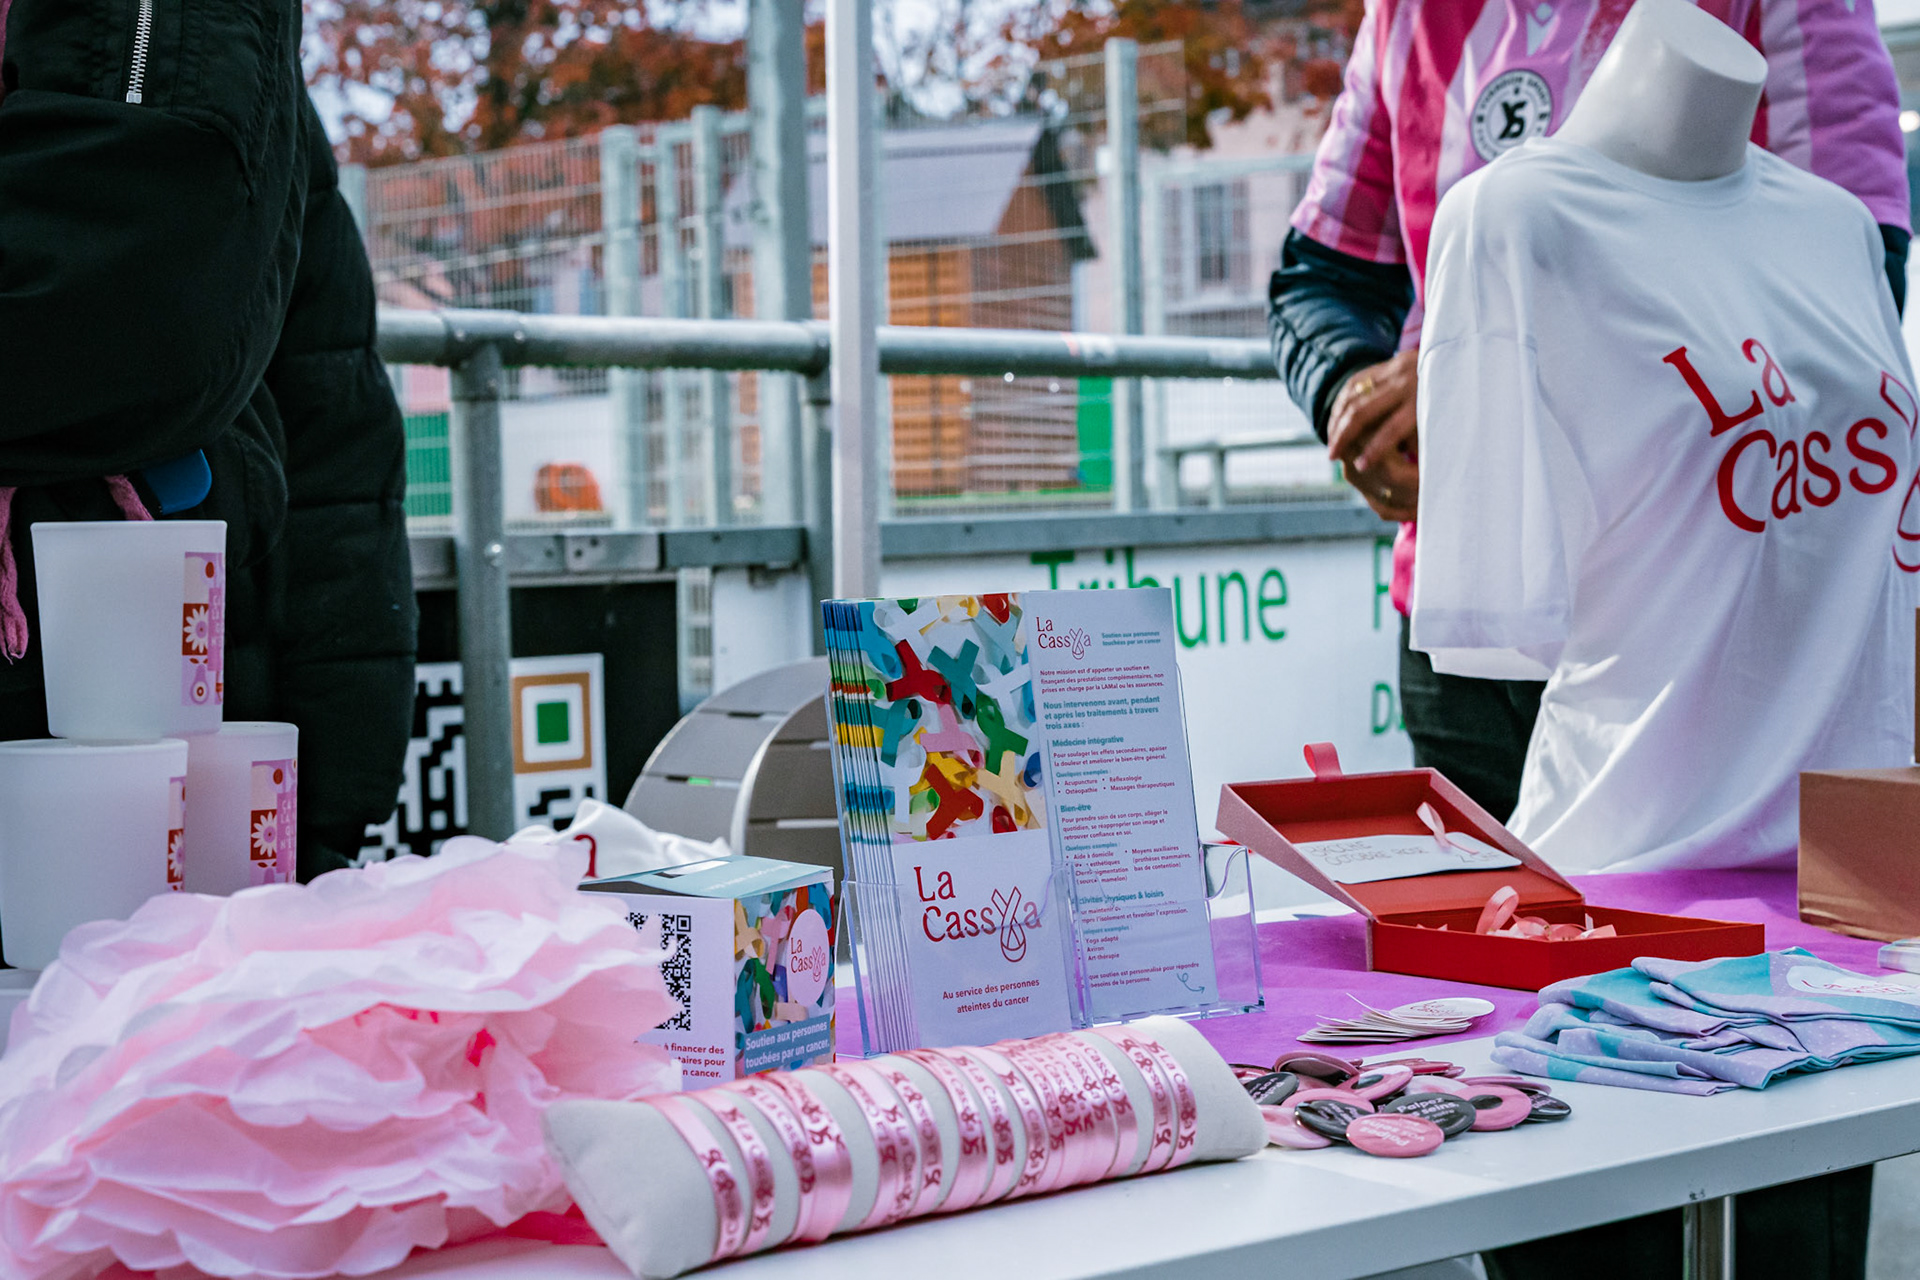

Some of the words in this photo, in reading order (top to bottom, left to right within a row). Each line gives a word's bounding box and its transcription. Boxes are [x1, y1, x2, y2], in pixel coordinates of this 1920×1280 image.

[1663, 338, 1796, 437] La
[1036, 617, 1053, 631] La
[1064, 700, 1106, 708] intervenons
[1131, 696, 1160, 704] pendant
[1087, 709, 1127, 717] traitements
[1087, 736, 1124, 745] intégrative
[914, 866, 956, 902] La
[1138, 891, 1143, 899] &
[791, 938, 802, 954] La
[1176, 962, 1199, 970] répondre
[943, 991, 953, 999] Au
[956, 987, 983, 998] service
[985, 985, 998, 993] des
[1000, 979, 1040, 993] personnes
[957, 1003, 990, 1013] atteintes
[993, 999, 1002, 1007] du
[1005, 996, 1029, 1006] cancer
[746, 1035, 776, 1050] Soutien
[777, 1032, 790, 1041] aux
[792, 1022, 827, 1041] personnes
[671, 1043, 706, 1053] financer
[709, 1046, 724, 1054] des
[746, 1051, 780, 1068] touchées
[782, 1048, 794, 1062] par
[796, 1045, 804, 1055] un
[806, 1039, 830, 1053] cancer.
[704, 1059, 725, 1067] pour
[690, 1069, 721, 1077] cancer.
[1396, 1097, 1443, 1113] Palpez
